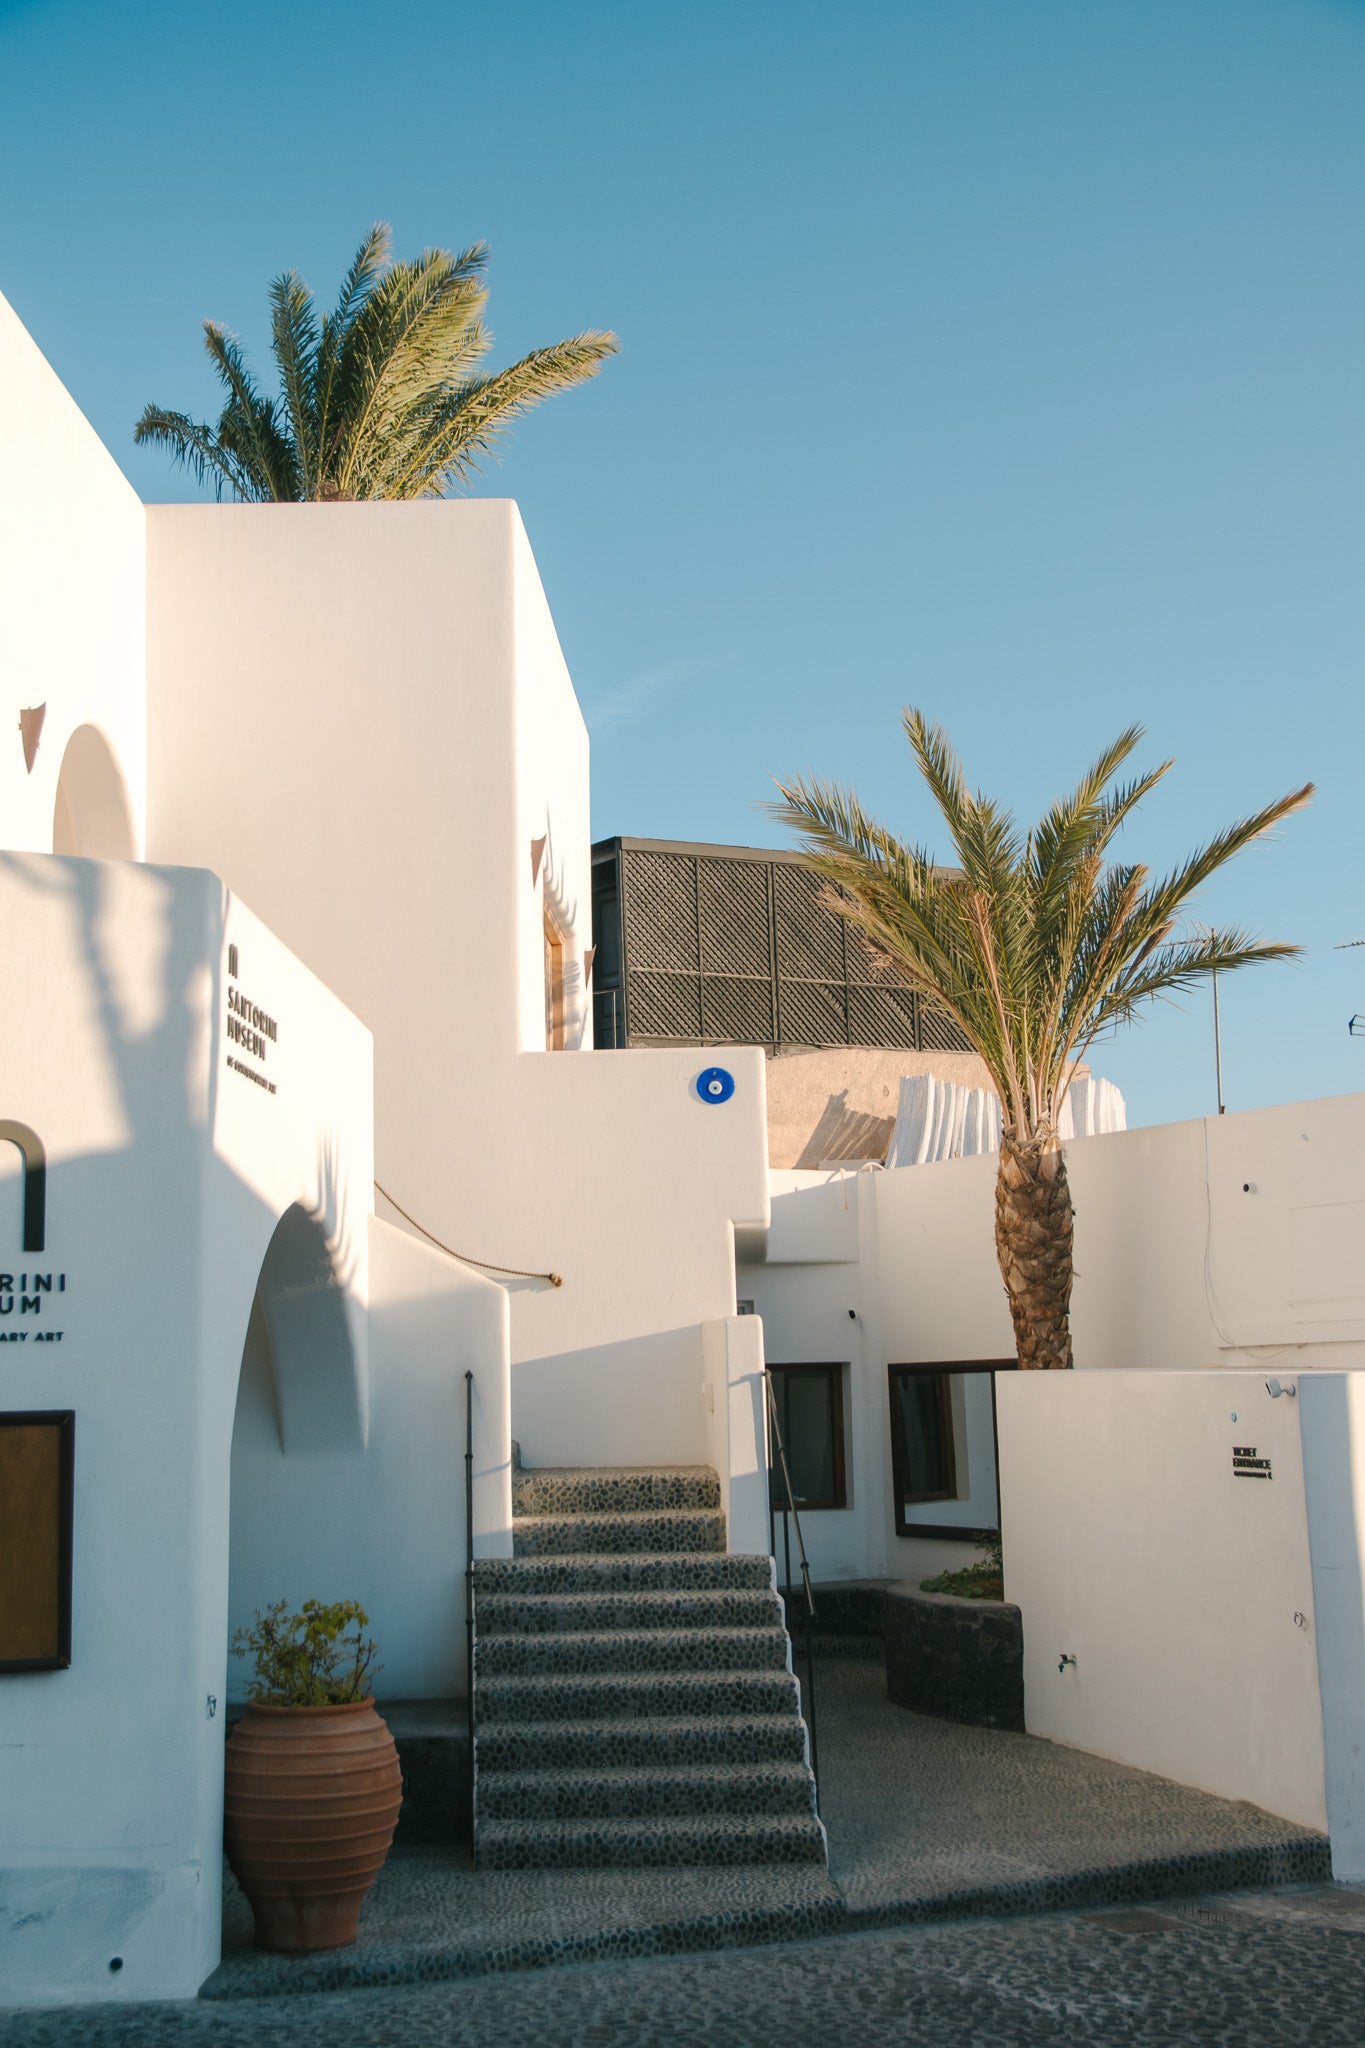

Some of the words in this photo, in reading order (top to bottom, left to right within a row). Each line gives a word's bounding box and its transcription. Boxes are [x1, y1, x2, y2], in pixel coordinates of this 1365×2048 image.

[228, 985, 278, 1043] SANTORINI
[227, 1014, 266, 1061] MUSEUM
[34, 1331, 65, 1342] ART
[1233, 1457, 1272, 1469] ENTRANCE
